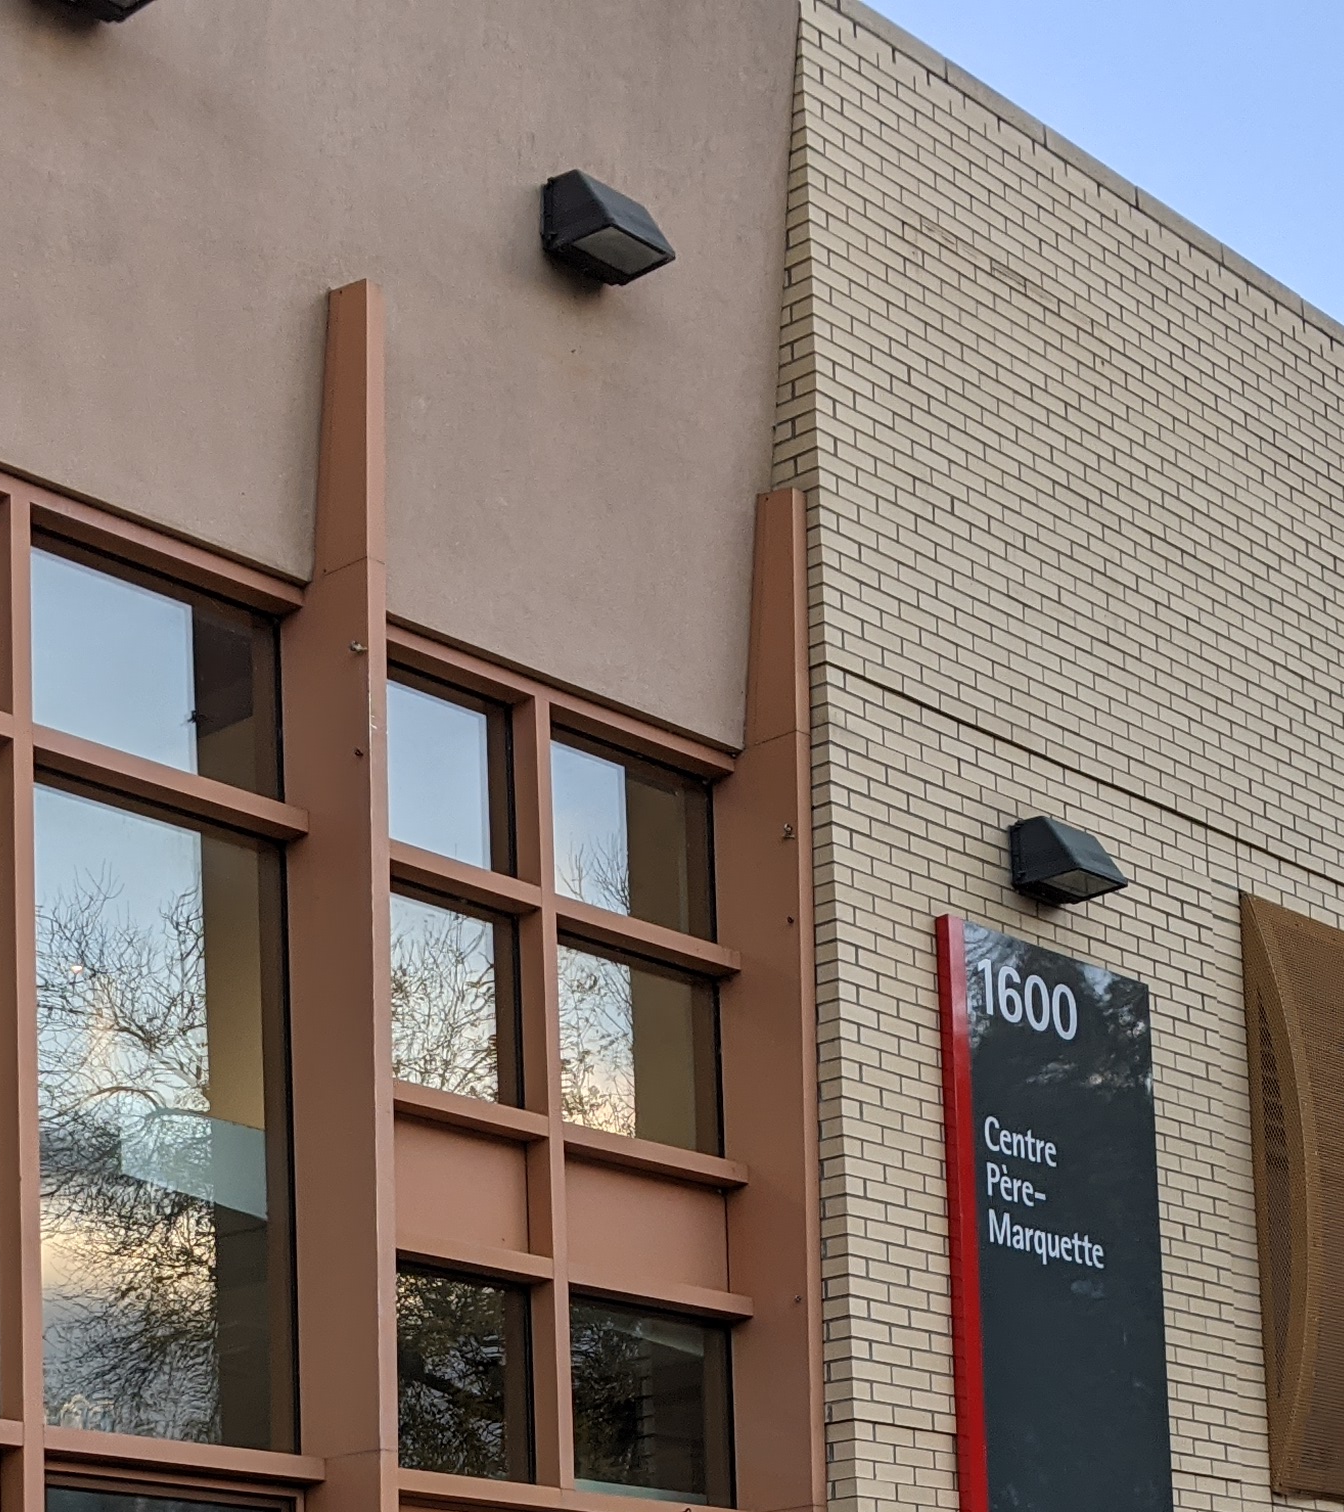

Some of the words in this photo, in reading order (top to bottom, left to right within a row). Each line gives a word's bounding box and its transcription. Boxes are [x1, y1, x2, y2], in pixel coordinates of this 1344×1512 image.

[977, 958, 1078, 1041] 1600
[984, 1115, 1057, 1168] Centre
[986, 1161, 1047, 1207] Père-
[988, 1208, 1105, 1270] Marquette
